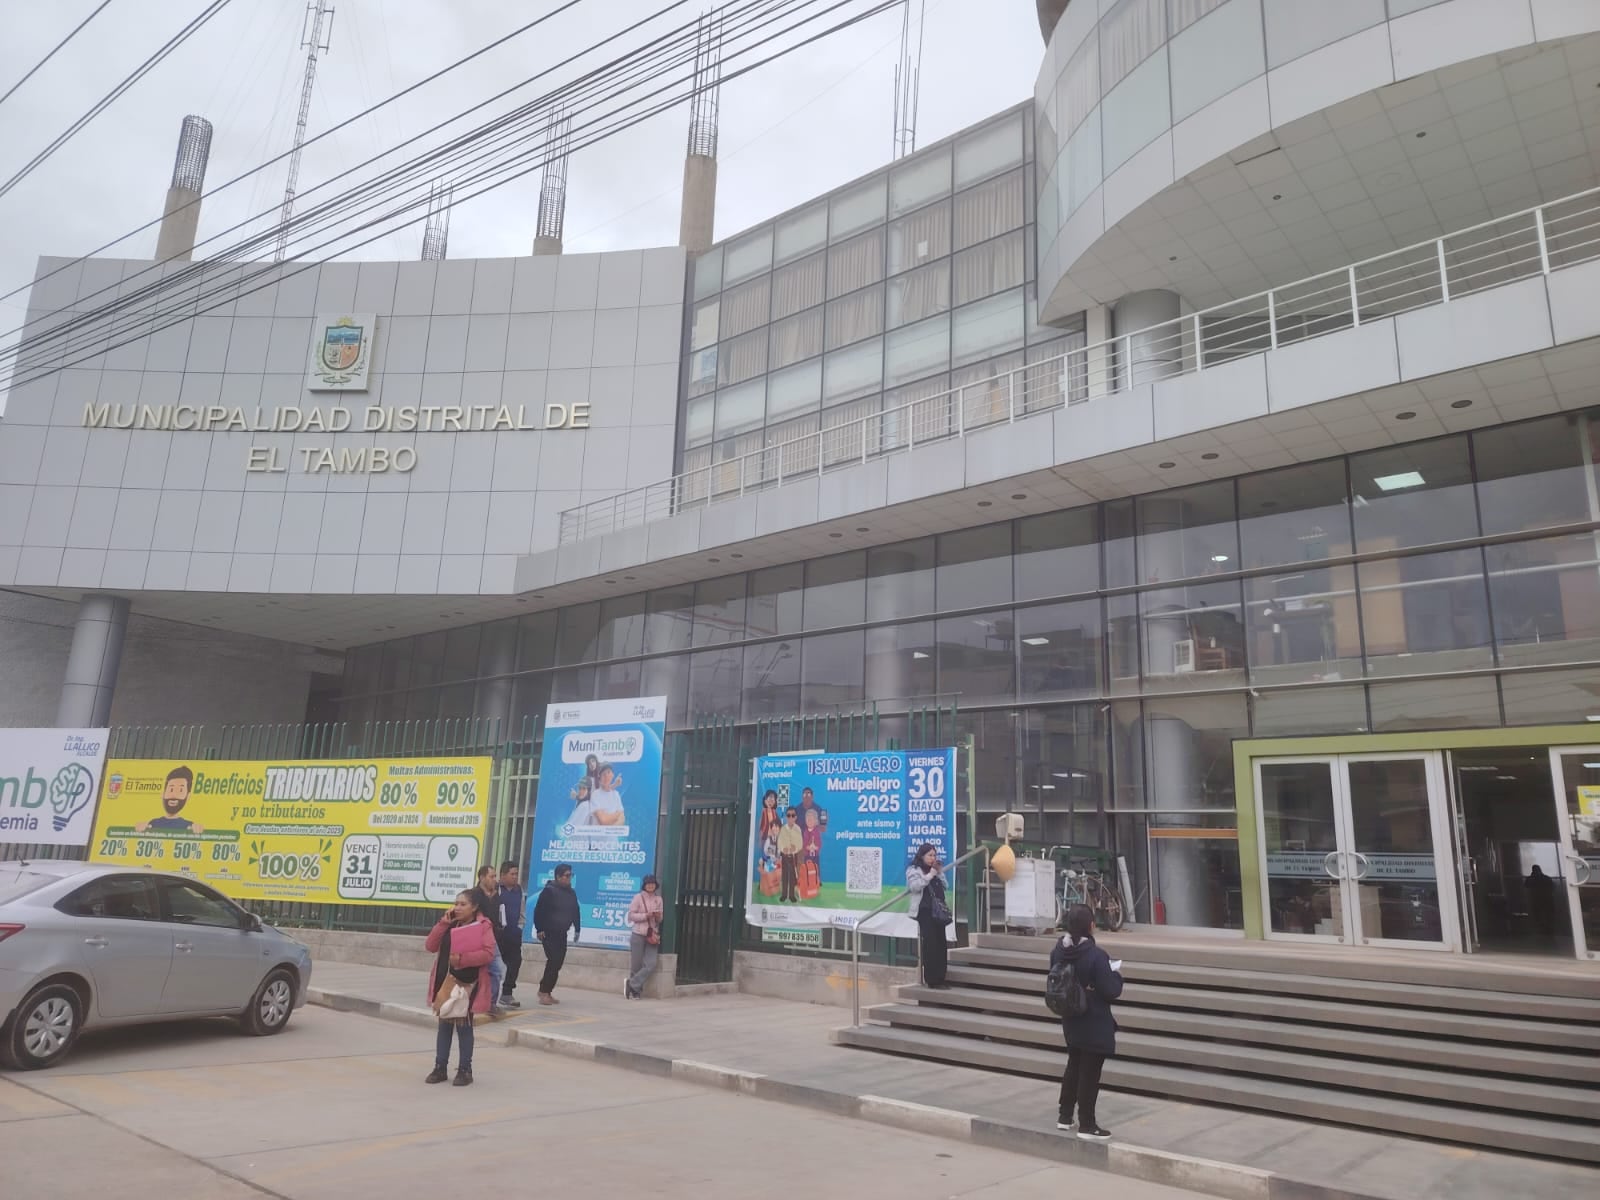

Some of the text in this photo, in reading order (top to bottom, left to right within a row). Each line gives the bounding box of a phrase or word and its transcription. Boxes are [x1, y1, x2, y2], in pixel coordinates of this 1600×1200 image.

[81, 402, 591, 432] MUNICIPALIDAD DISTRITAL DE
[246, 446, 418, 473] EL TAMBO
[815, 756, 902, 775] SIMULACRO
[908, 756, 945, 767] VIERNES
[125, 781, 163, 791] El Tambo
[193, 765, 378, 802] Beneficios TRIBUTARIOS
[827, 777, 901, 793] Multipeligro
[908, 766, 945, 798] 30
[230, 803, 326, 820] y no tributarios
[857, 794, 901, 813] 2025
[911, 799, 941, 811] MAYO
[857, 820, 871, 828] ante
[873, 820, 894, 828] sismo
[908, 825, 947, 836] LUGAR:
[836, 831, 901, 840] peligros asociados
[100, 839, 128, 857] 20%
[135, 840, 164, 858] 30%
[173, 842, 202, 860] 50%
[212, 843, 241, 862] 80%
[346, 844, 378, 854] VENCE
[591, 841, 641, 852] DOCENTES
[346, 854, 373, 875] 31
[542, 849, 646, 864] MEJORES RESULTADOS
[259, 853, 321, 880] 100%
[344, 877, 371, 888] JULIO
